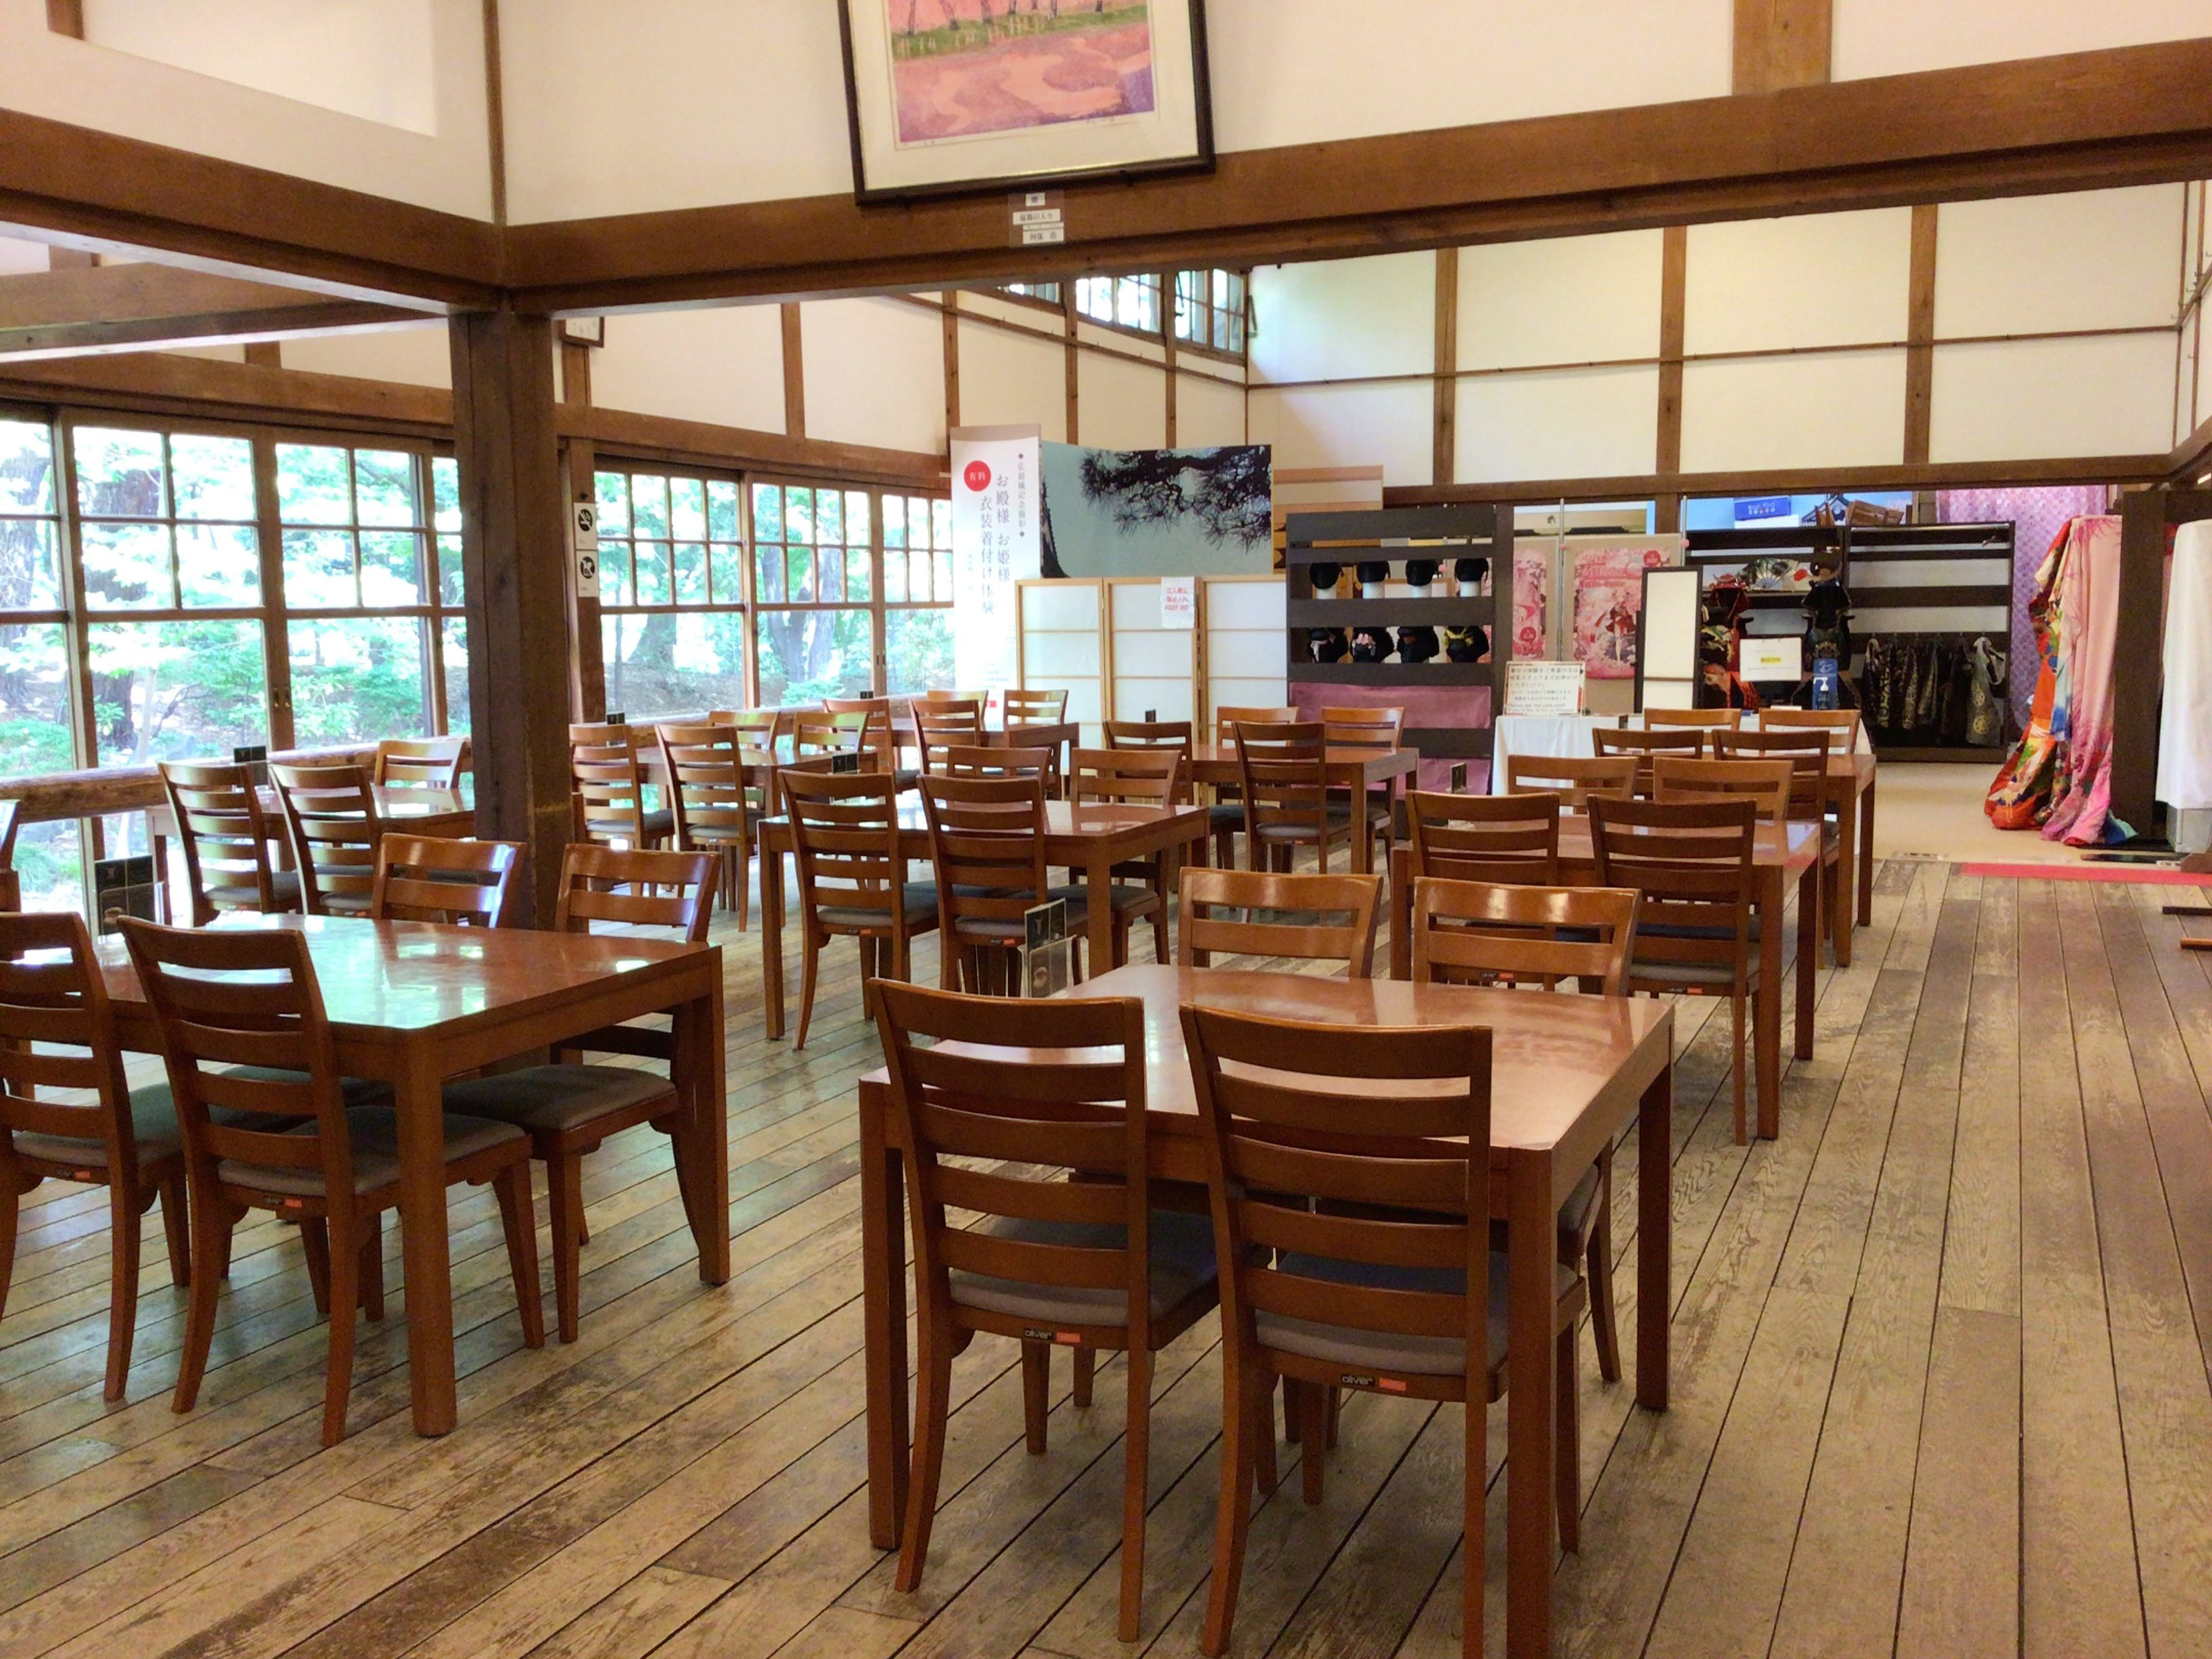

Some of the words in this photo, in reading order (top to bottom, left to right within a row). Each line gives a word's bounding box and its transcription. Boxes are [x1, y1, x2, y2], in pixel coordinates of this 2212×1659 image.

[969, 471, 985, 481] 有料
[996, 474, 1010, 524] お殿様
[980, 495, 994, 615] 衣装着付け体験
[998, 533, 1010, 582] お姫様
